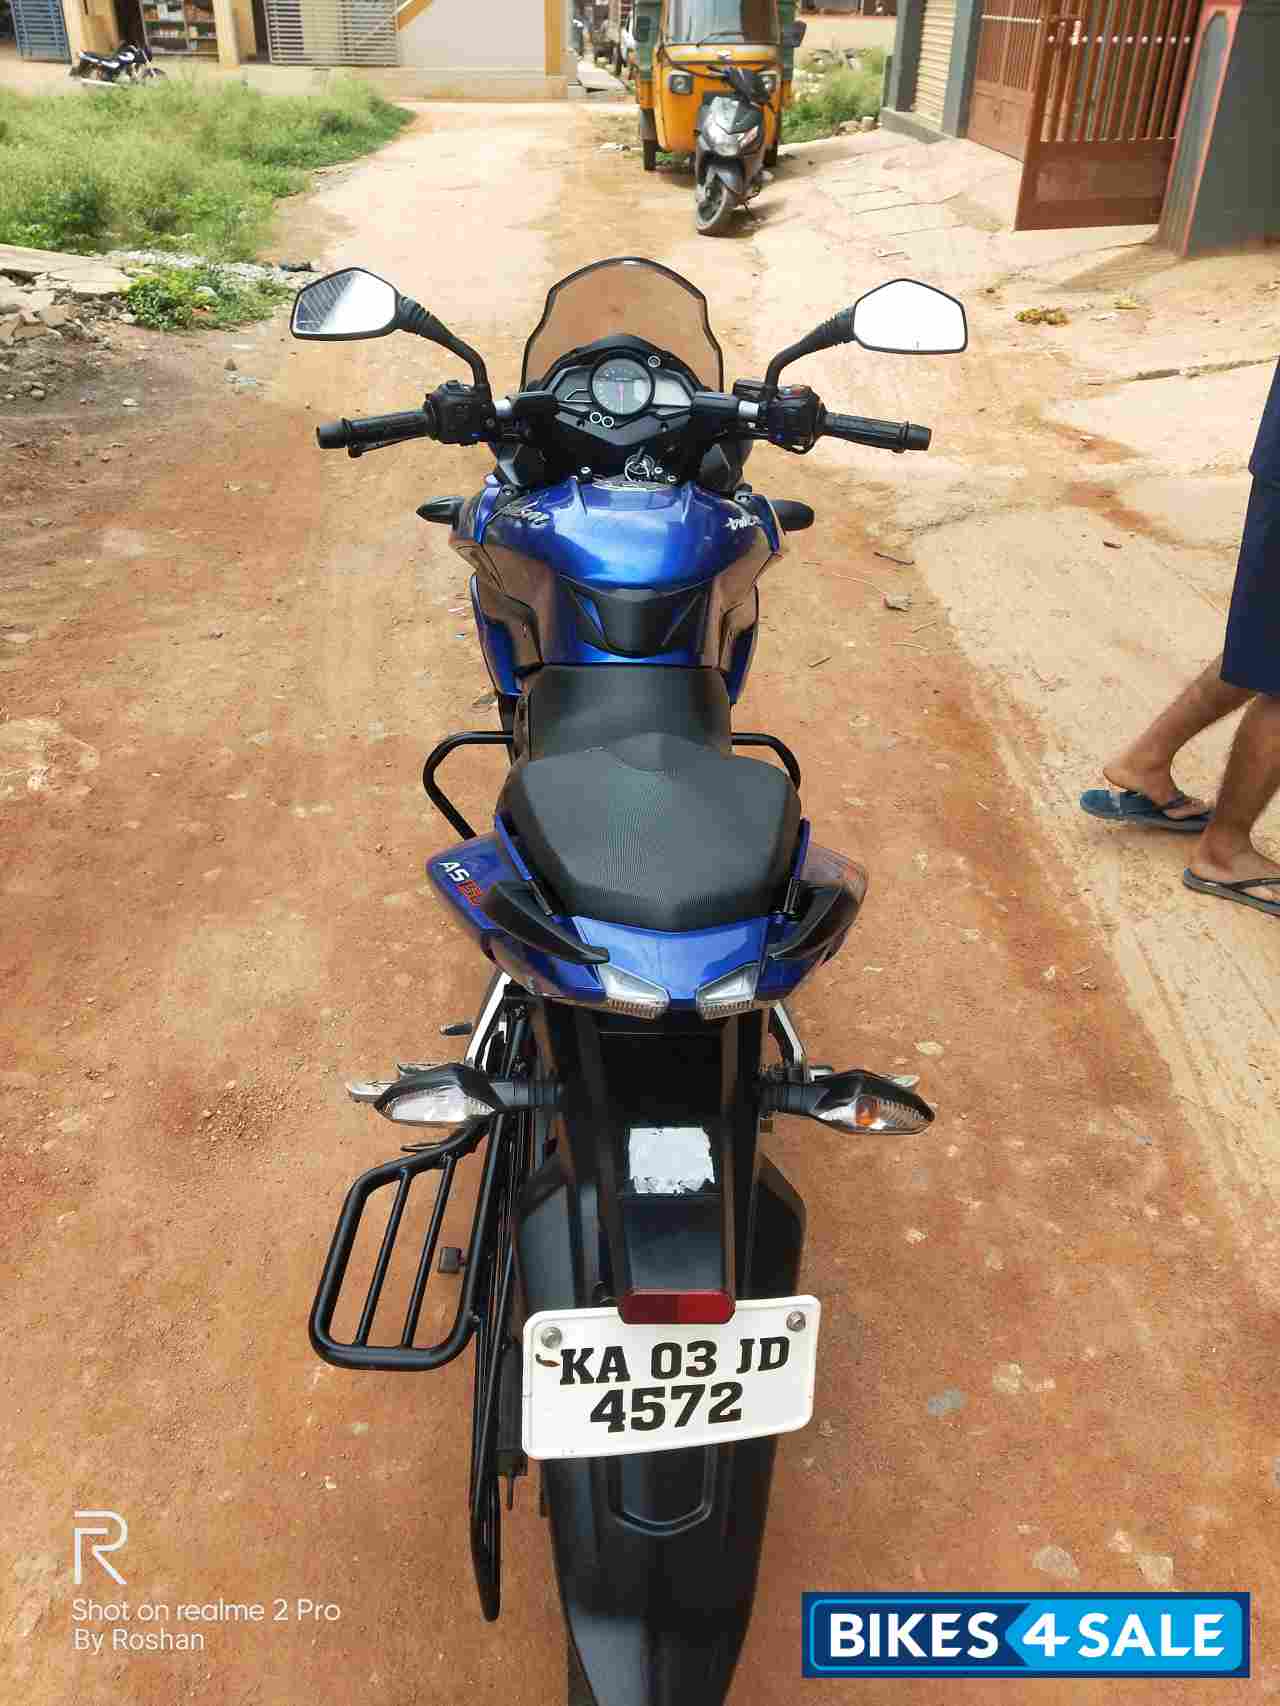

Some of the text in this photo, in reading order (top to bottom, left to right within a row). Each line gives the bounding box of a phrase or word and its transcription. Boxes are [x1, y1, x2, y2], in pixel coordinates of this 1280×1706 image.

[559, 1336, 790, 1386] KA 03 JD
[590, 1381, 743, 1433] 4572
